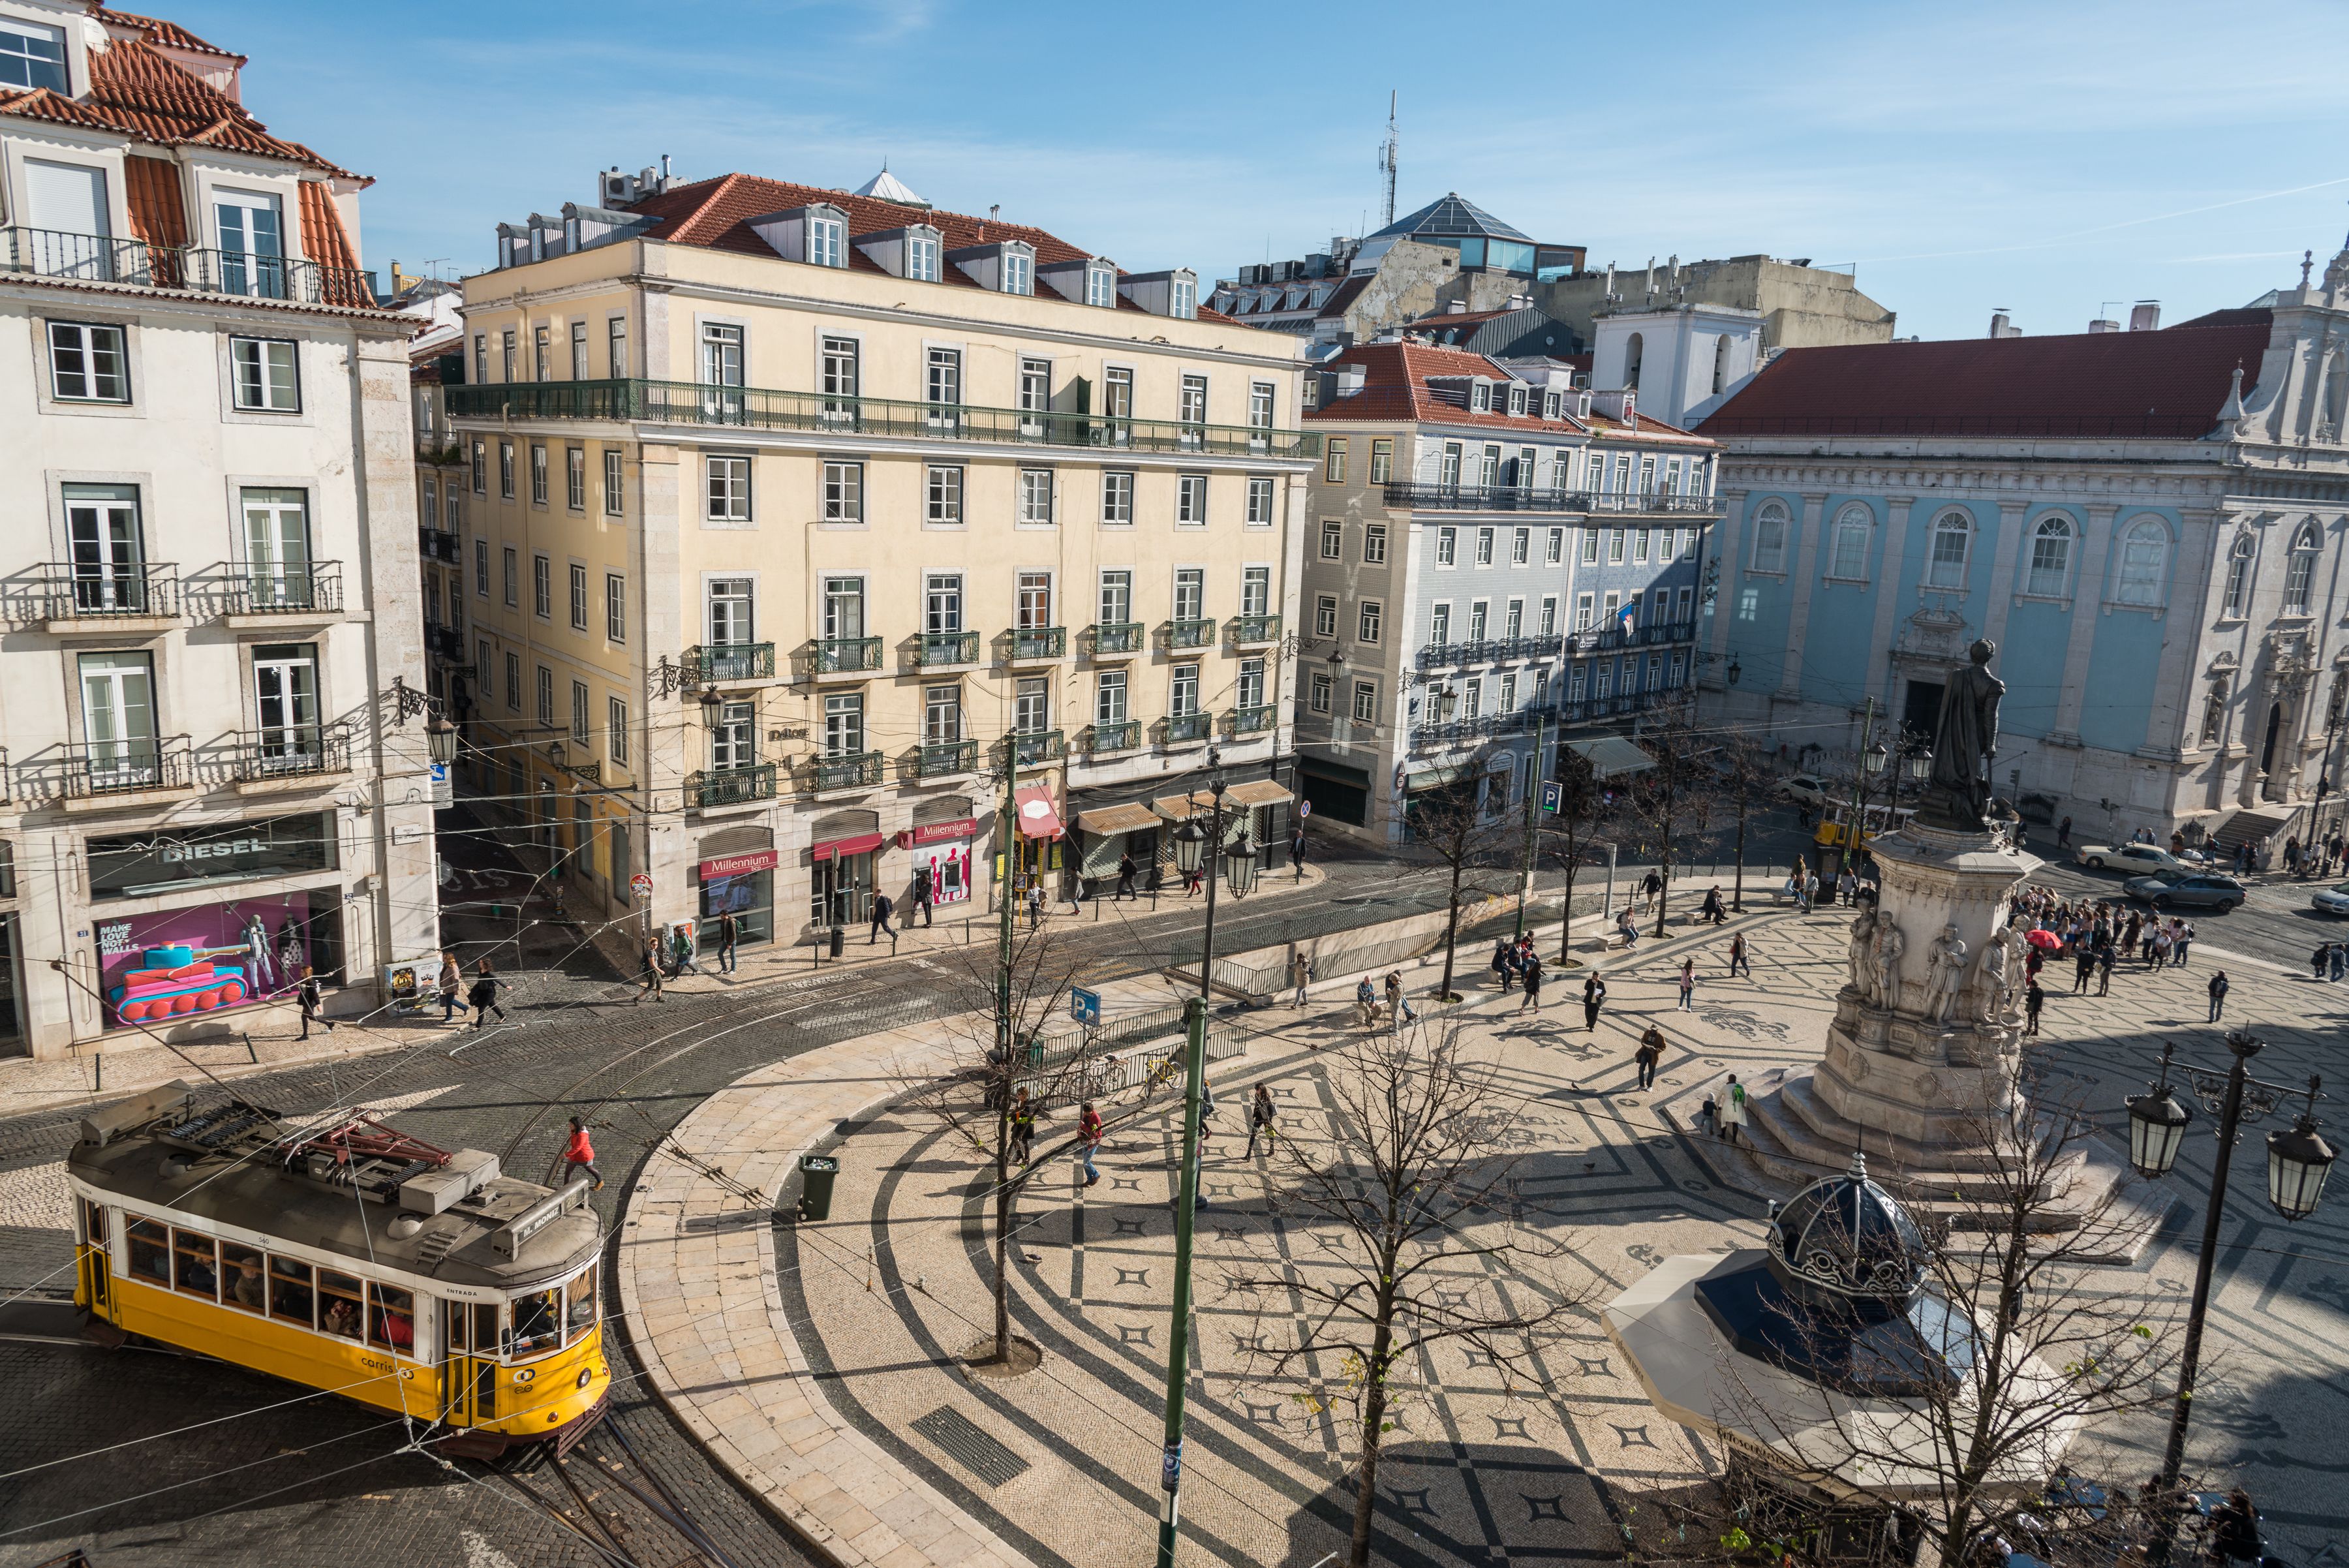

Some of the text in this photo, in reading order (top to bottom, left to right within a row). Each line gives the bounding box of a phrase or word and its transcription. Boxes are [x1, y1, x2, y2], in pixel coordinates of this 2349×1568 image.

[924, 822, 970, 837] Millennium
[900, 837, 908, 849] M
[163, 838, 267, 863] DIESEL
[712, 855, 769, 872] Millennium
[100, 923, 132, 934] MAKE
[101, 931, 129, 941] LOVE
[101, 939, 124, 949] NOT
[102, 944, 139, 955] WALLS
[523, 1206, 559, 1237] M. MONIZ
[447, 1288, 478, 1297] ENTRADA
[361, 1357, 393, 1374] carris
